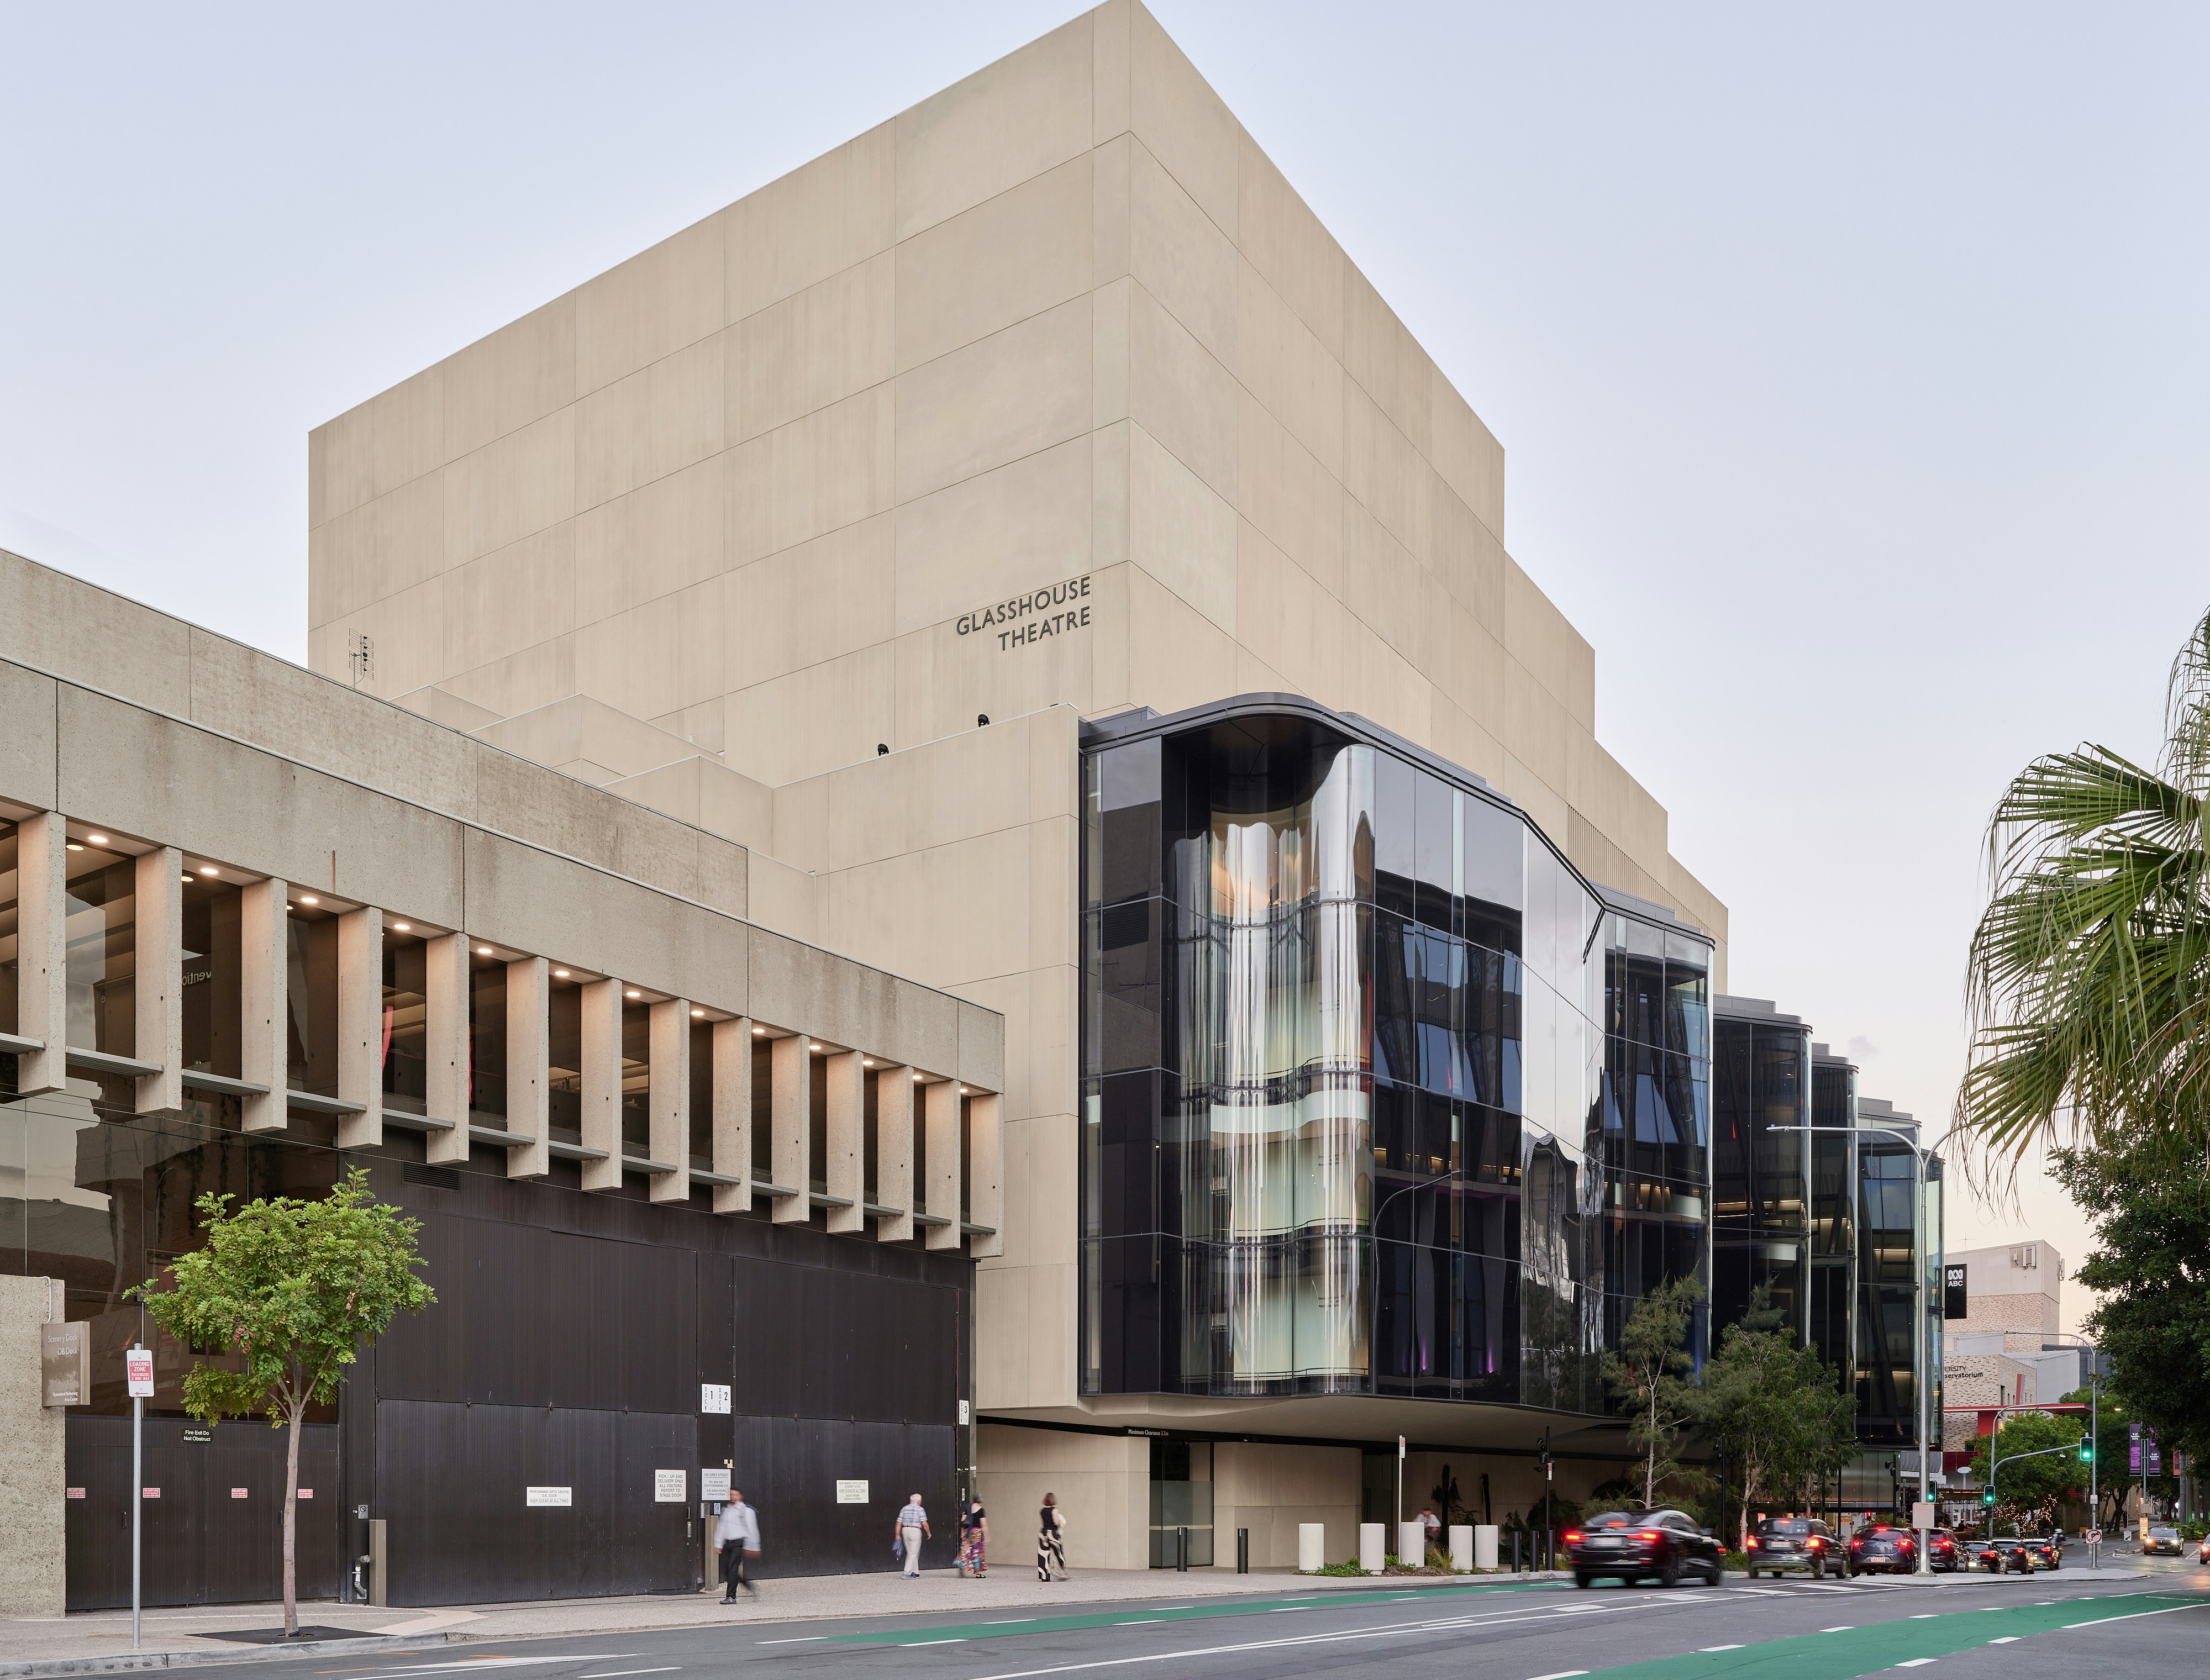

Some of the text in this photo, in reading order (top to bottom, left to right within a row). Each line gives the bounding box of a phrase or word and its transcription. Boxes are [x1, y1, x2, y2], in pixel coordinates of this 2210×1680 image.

[956, 576, 1090, 635] GLASSHOUSE
[998, 605, 1090, 651] THEATRE
[711, 1391, 713, 1400] 1
[724, 1392, 727, 1401] 2
